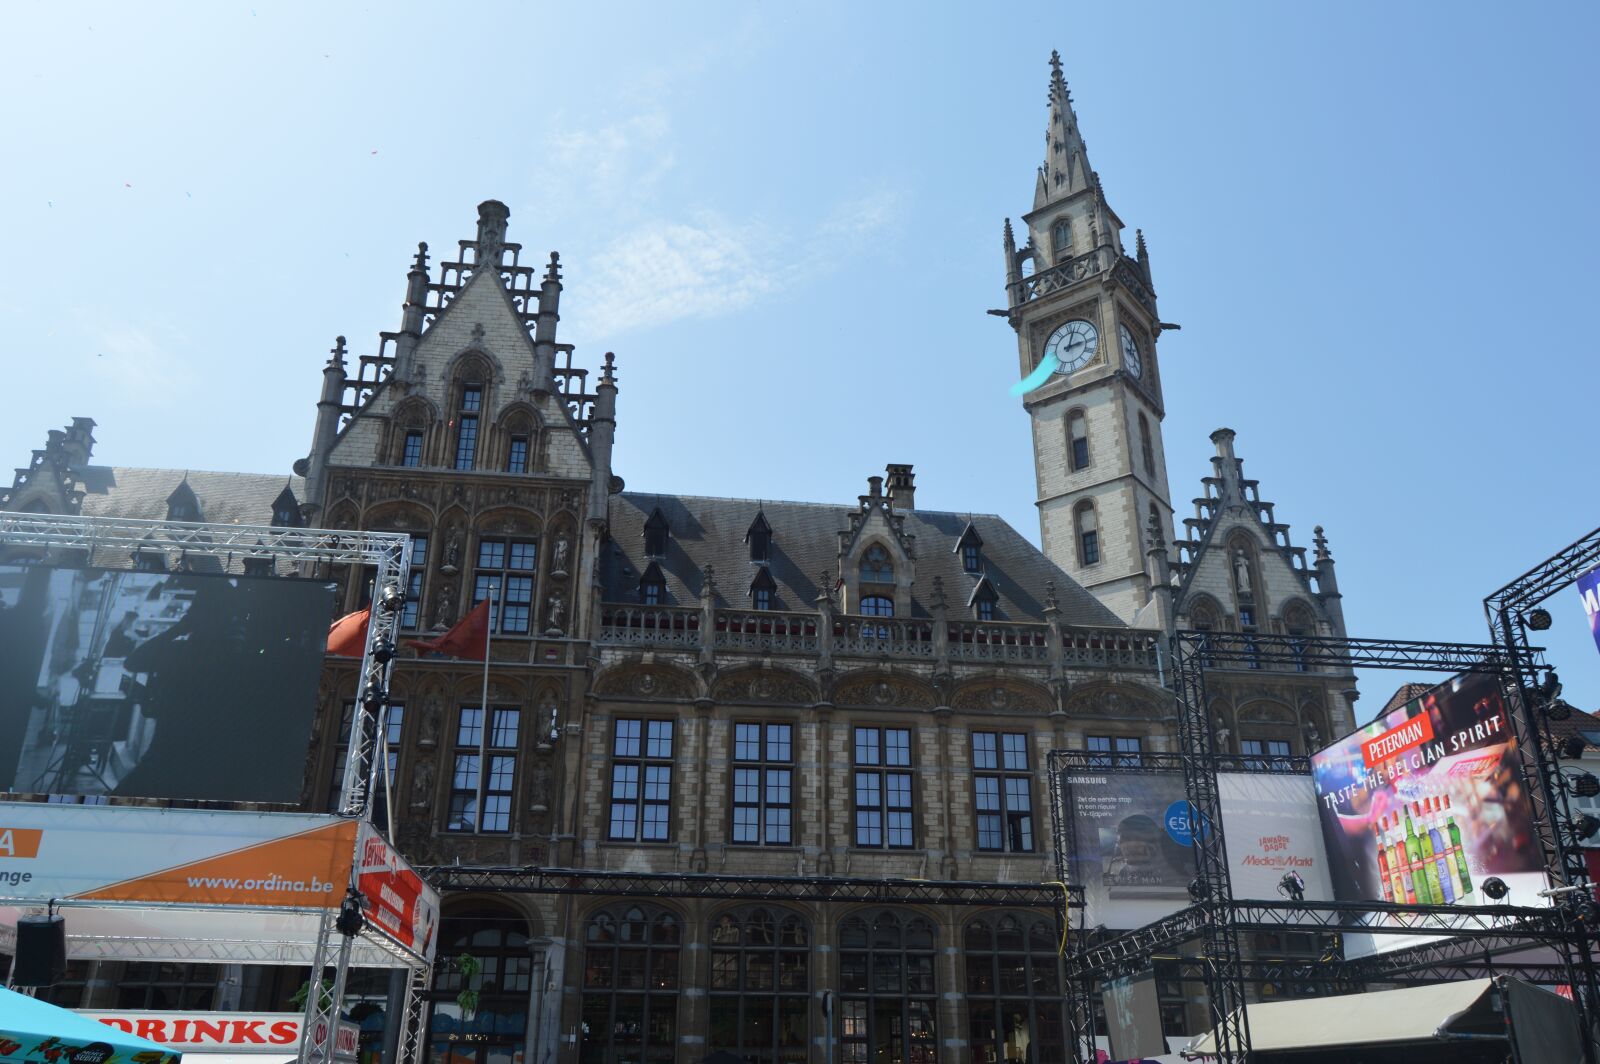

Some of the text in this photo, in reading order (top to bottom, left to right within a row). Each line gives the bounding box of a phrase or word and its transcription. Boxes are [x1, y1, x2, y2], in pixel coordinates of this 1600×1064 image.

[1369, 721, 1424, 762] PETERMAN
[1324, 715, 1500, 809] TASTE THE BELGIAN SPIRIT
[1067, 776, 1107, 784] SAMSUNG
[187, 873, 334, 893] www.ordina.be
